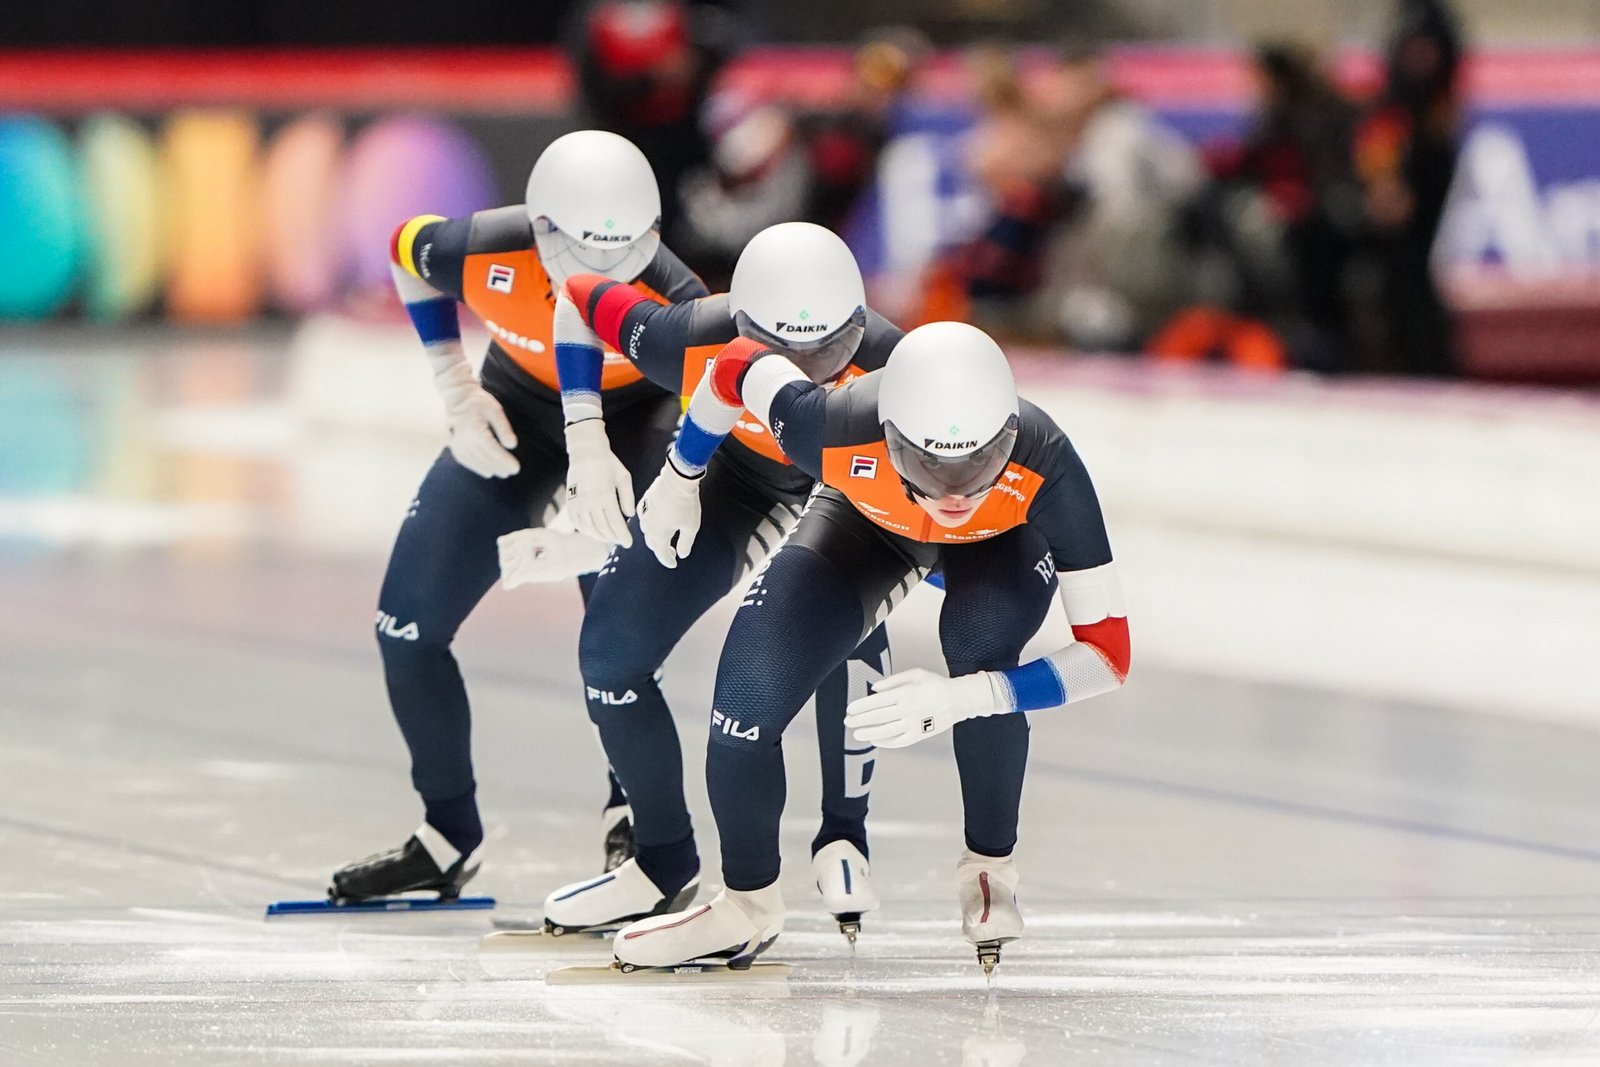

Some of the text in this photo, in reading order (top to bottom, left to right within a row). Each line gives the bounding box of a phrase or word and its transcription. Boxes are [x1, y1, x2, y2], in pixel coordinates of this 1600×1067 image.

[593, 234, 631, 242] DAIKIN
[786, 324, 828, 333] DAIKIN
[934, 440, 978, 450] DAIKIN
[586, 685, 639, 705] FILA
[711, 709, 760, 741] FILA
